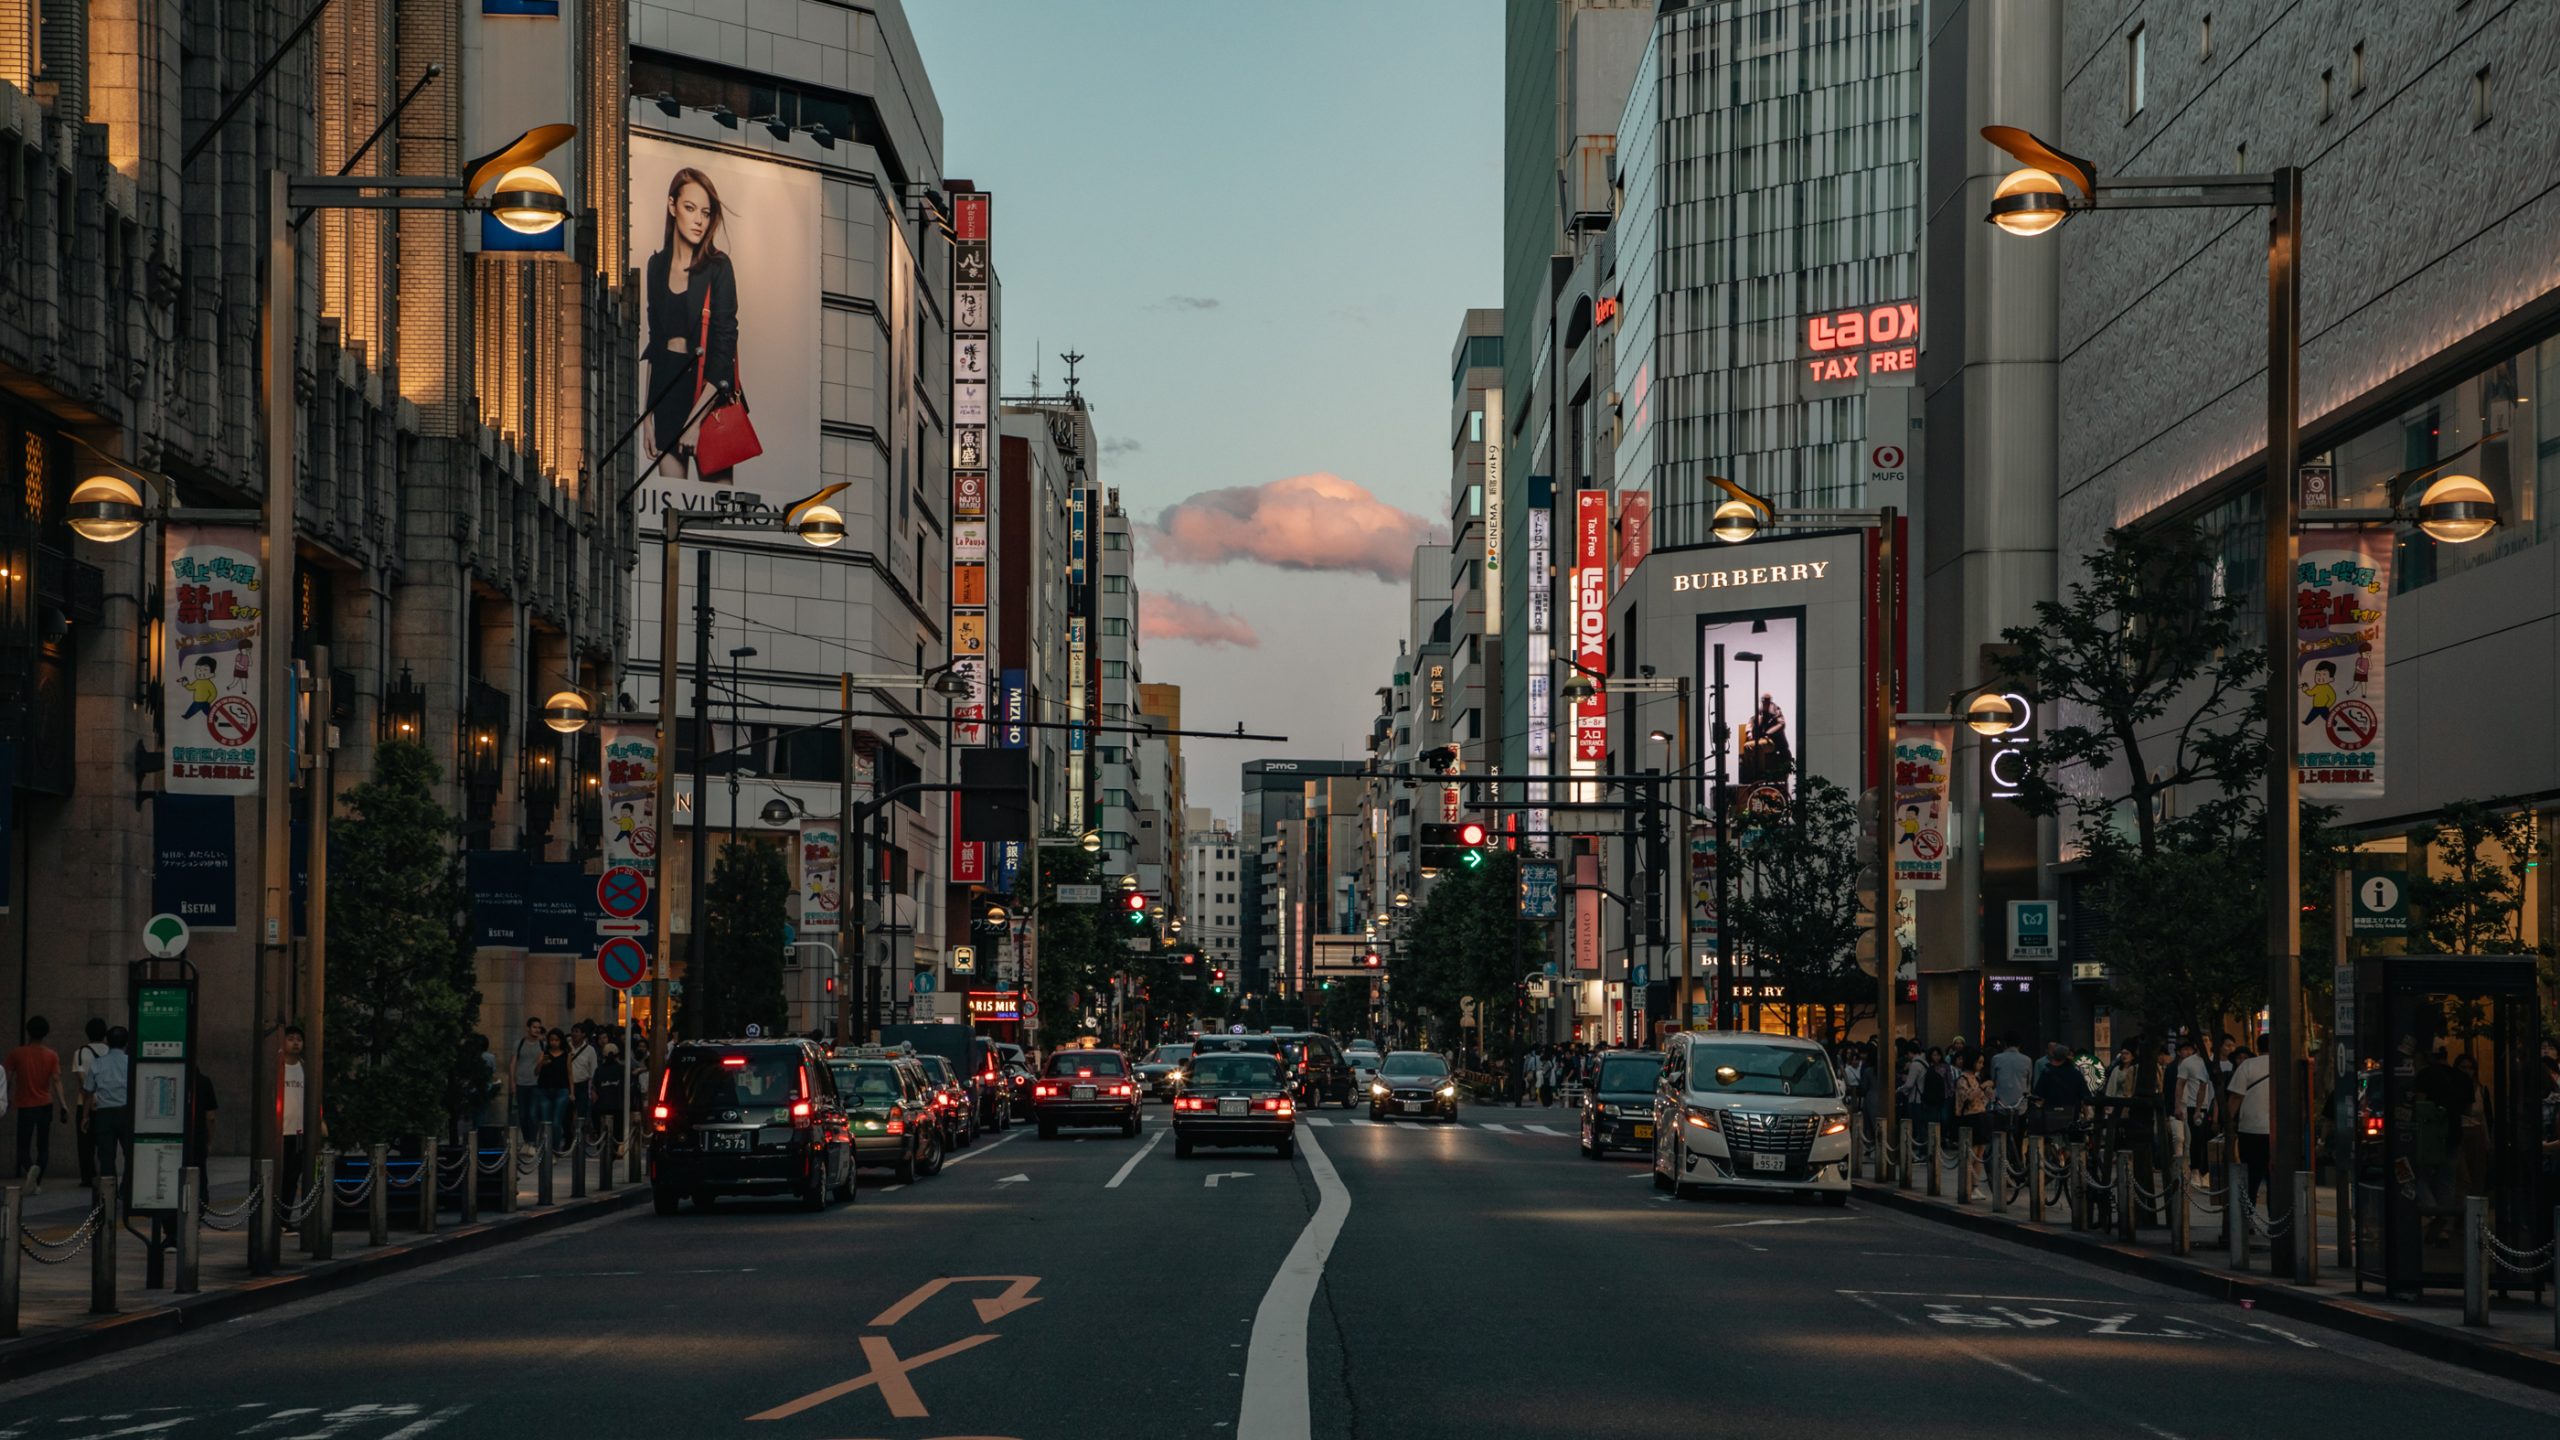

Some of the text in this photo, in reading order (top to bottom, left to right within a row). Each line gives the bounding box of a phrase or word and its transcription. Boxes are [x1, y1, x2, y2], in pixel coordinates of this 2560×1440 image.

[961, 292, 976, 327] ねぎし
[1810, 347, 1917, 381] TAX FRE
[1872, 472, 1904, 481] MUFG
[1490, 503, 1498, 548] CINEMA
[1588, 517, 1598, 557] Tax Free
[1673, 561, 1829, 592] BURBERRY
[1431, 665, 1445, 722] 成信ビル
[1010, 688, 1022, 744] MIZUHO
[1584, 731, 1601, 739] 入口
[1265, 763, 1298, 772] pmo
[1491, 766, 1499, 795] ANEX
[1443, 745, 1459, 822] 画材
[181, 901, 216, 914] ISETAN
[995, 1001, 1016, 1012] MIK
[1760, 1161, 1784, 1169] 95-27
